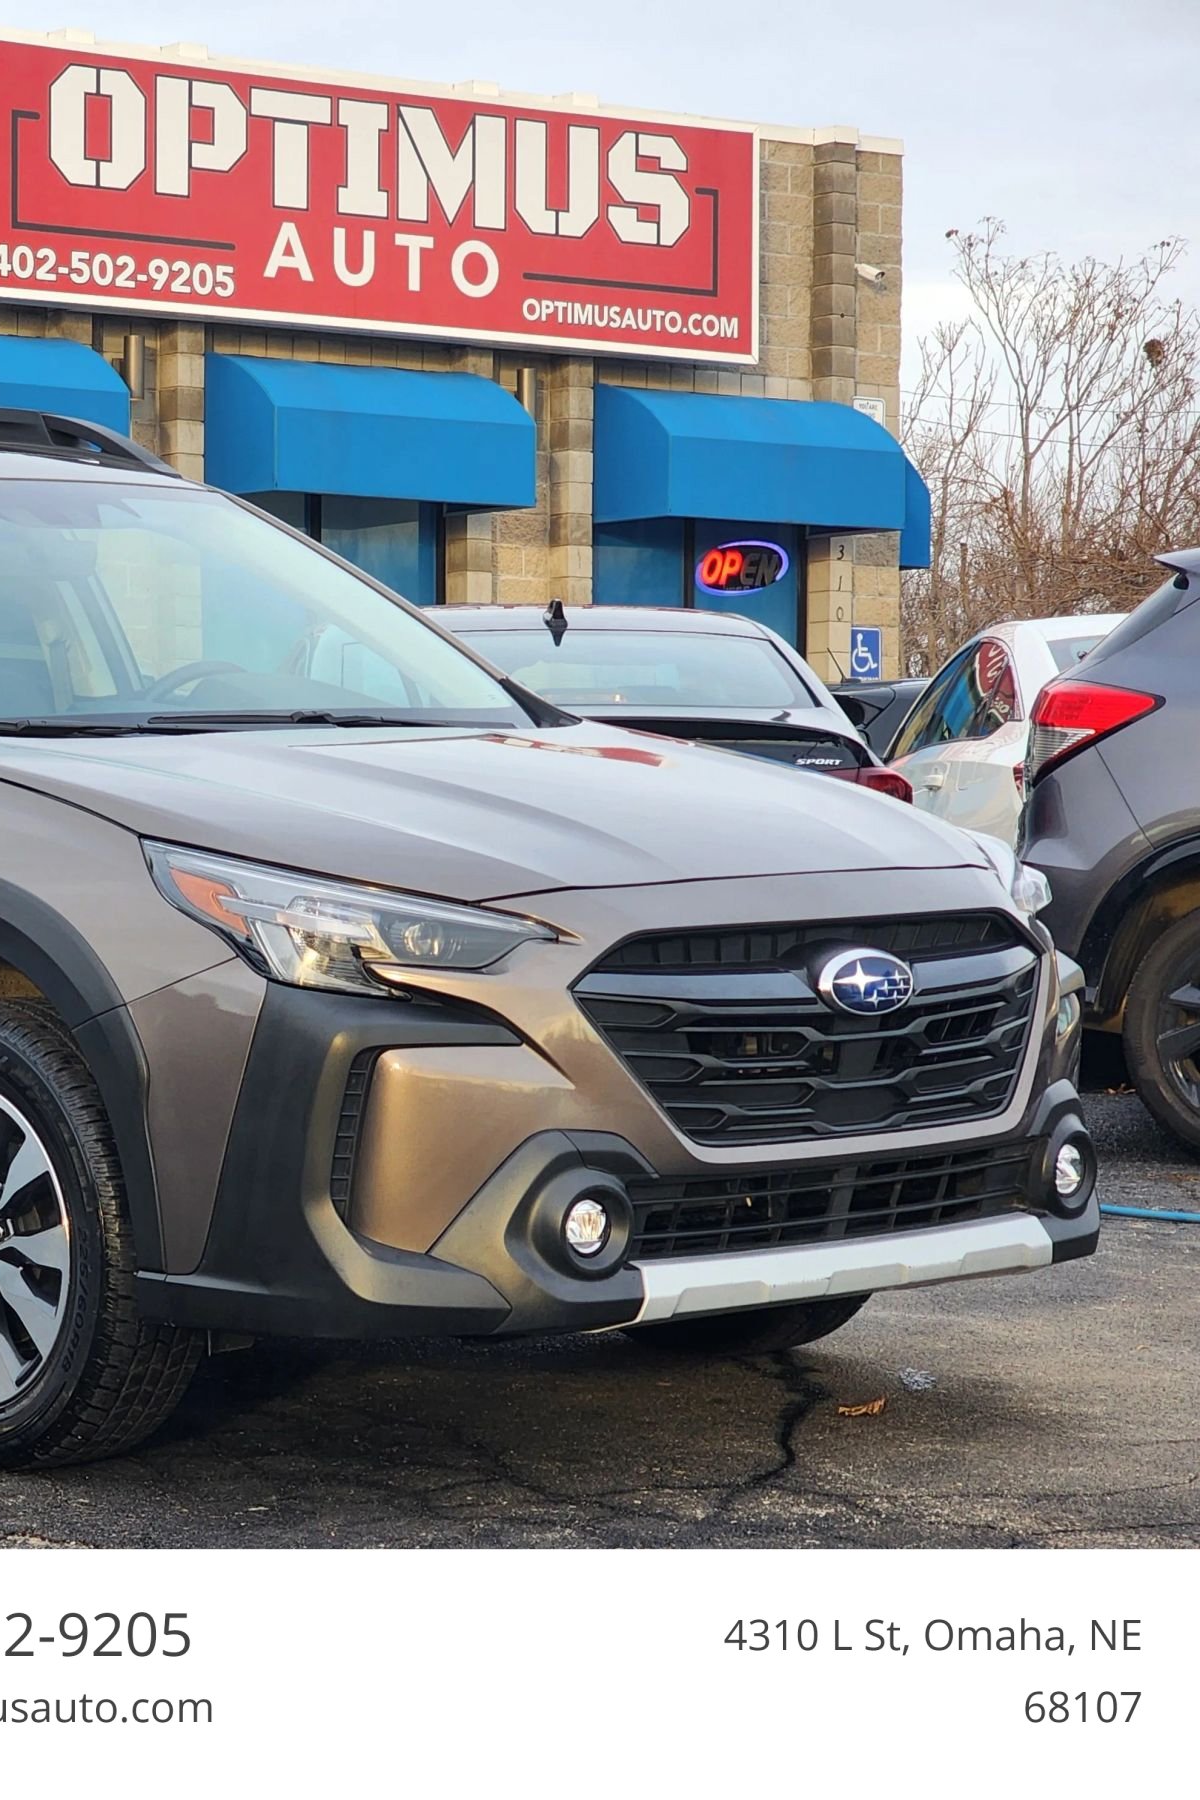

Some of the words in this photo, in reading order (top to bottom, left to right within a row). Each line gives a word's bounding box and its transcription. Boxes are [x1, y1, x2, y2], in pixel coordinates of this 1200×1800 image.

[49, 63, 692, 247] OPTIMUS
[263, 222, 500, 299] AUTO
[522, 298, 739, 340] OPTIMUSAUTO.COM
[701, 548, 779, 586] OPEN
[795, 758, 843, 766] SPORT
